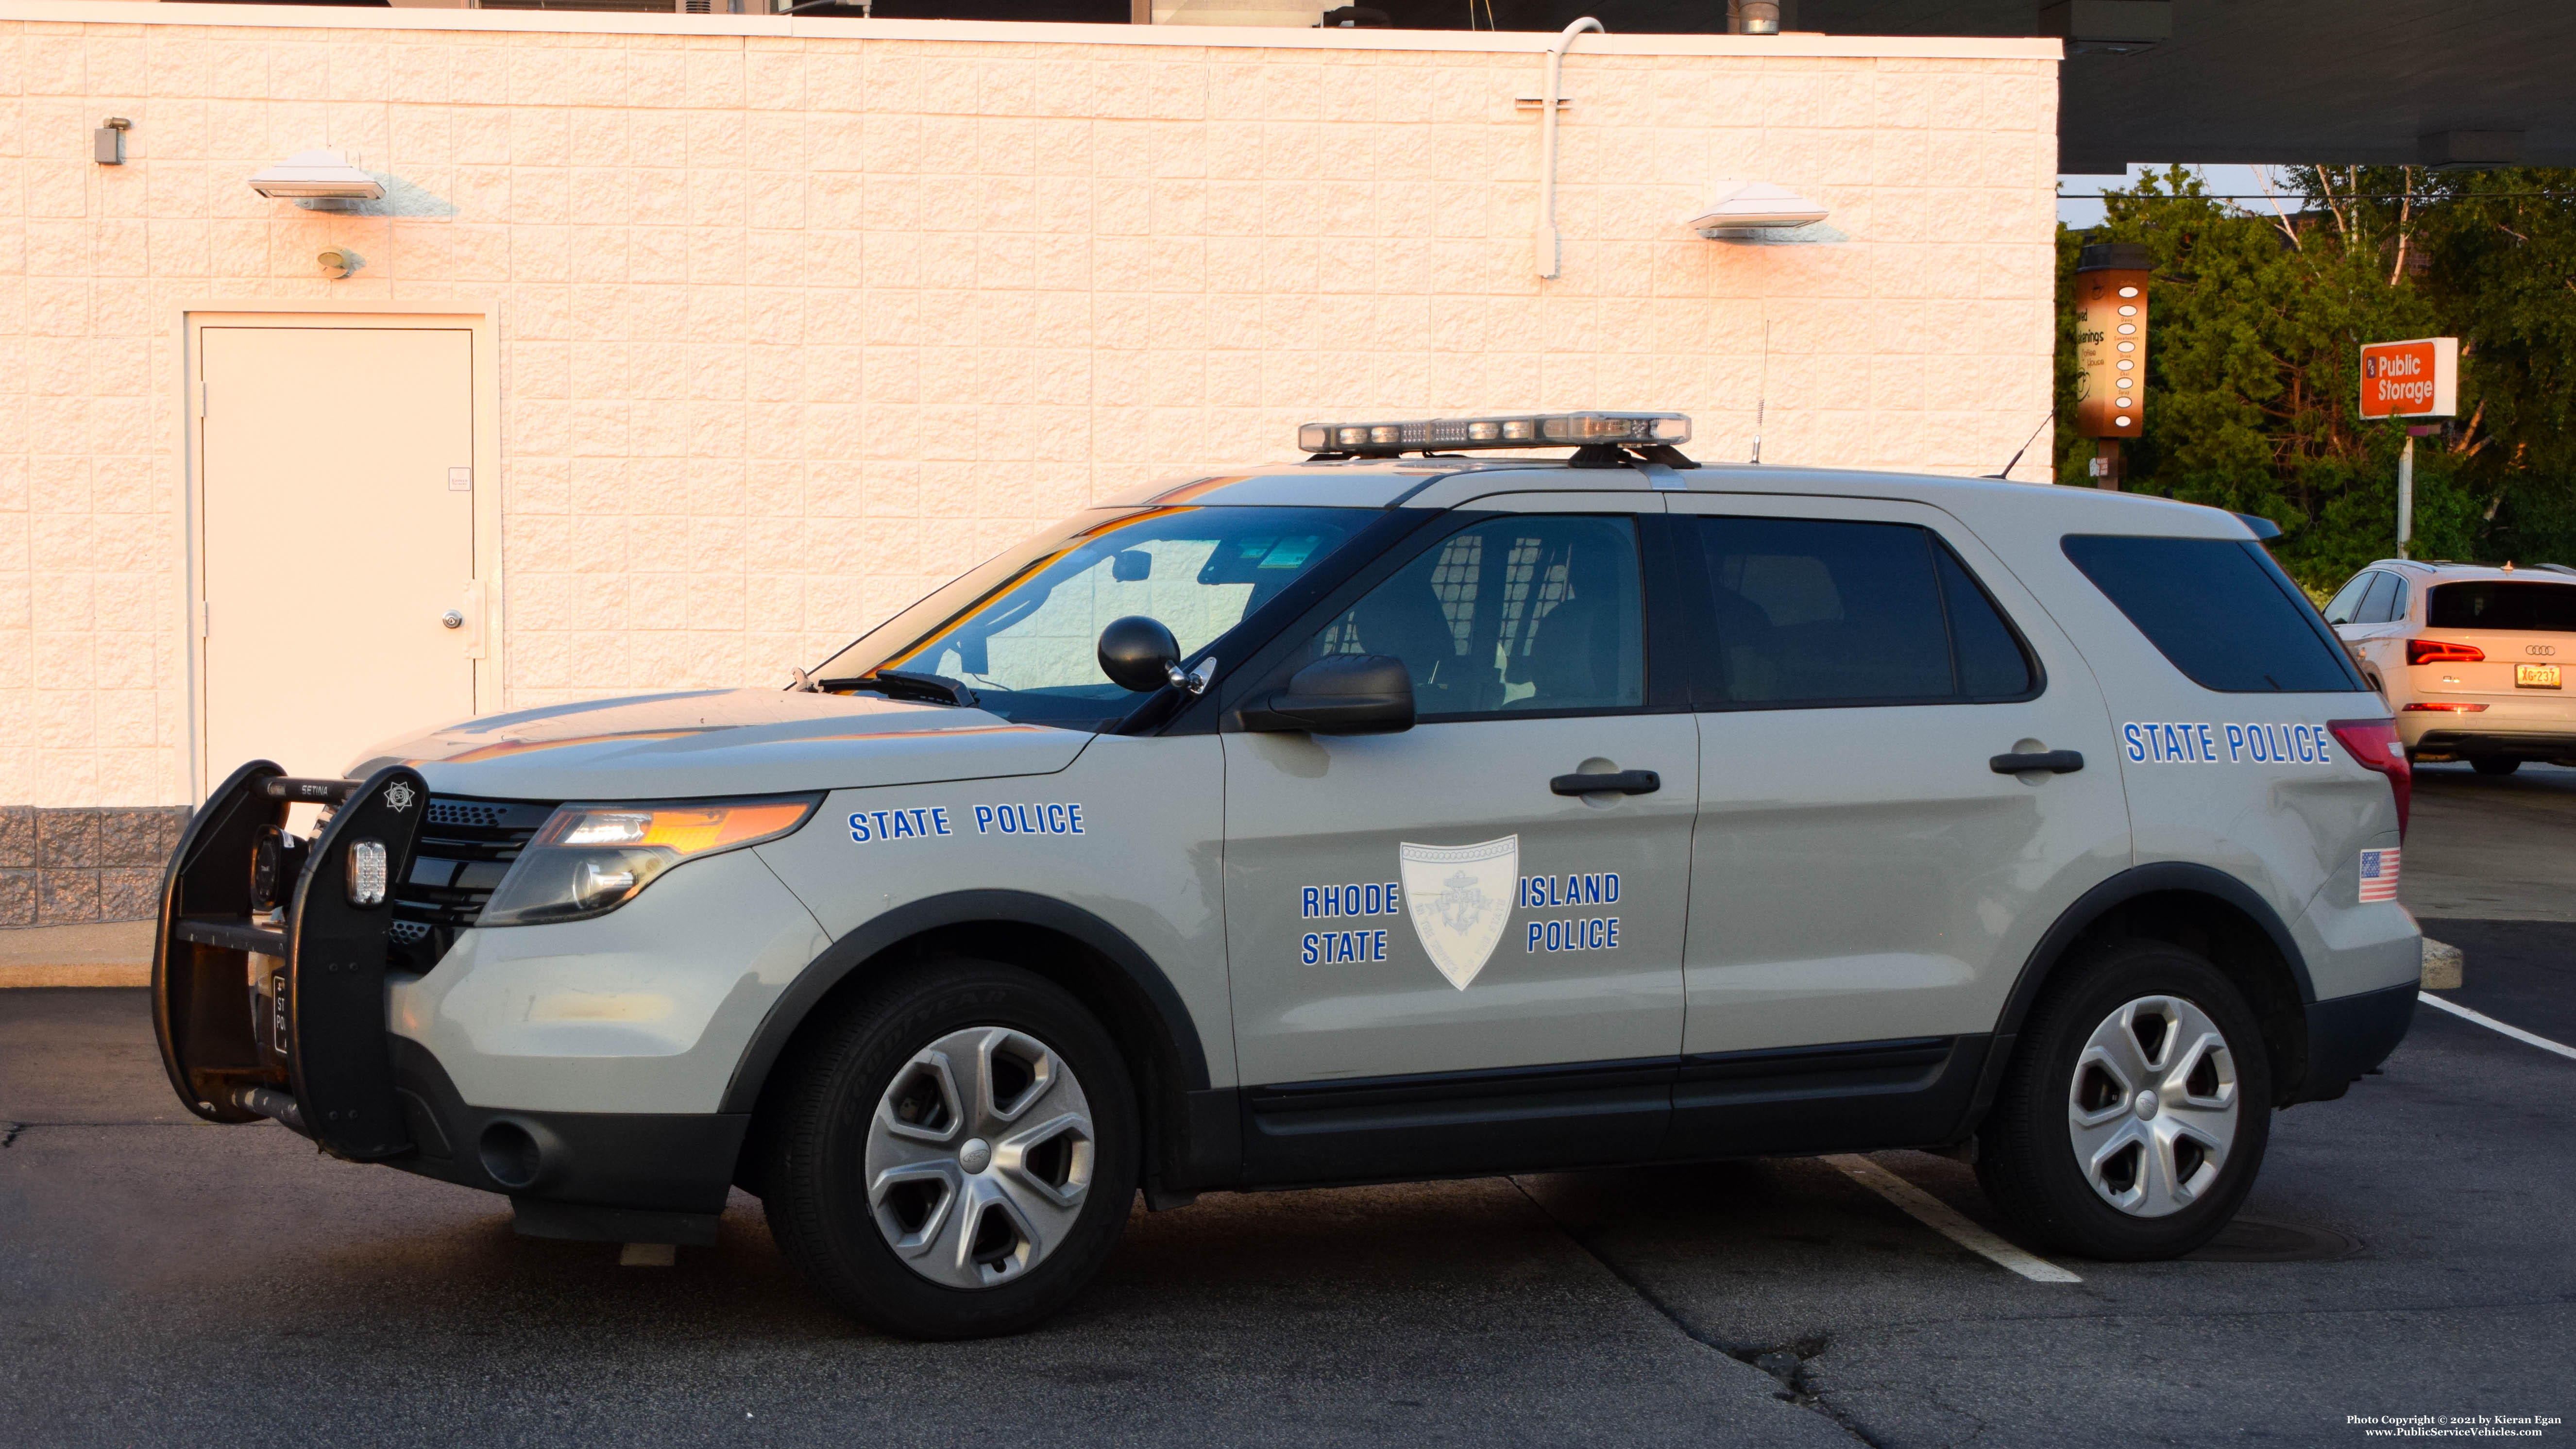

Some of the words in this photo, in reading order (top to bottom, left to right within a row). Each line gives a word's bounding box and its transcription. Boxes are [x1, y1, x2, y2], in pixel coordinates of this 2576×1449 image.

[2087, 358, 2104, 369] House
[2379, 354, 2421, 377] Public
[2378, 379, 2433, 404] Storage
[2122, 722, 2218, 764] STATE
[2223, 723, 2331, 764] POLICE
[302, 785, 328, 796] SETINA
[847, 806, 953, 843] STATE
[973, 803, 1085, 835] POLICE
[1302, 882, 1399, 919] RHODE
[1520, 872, 1620, 908] ISLAND
[1302, 929, 1388, 965] STATE
[1526, 916, 1620, 953] POLICE
